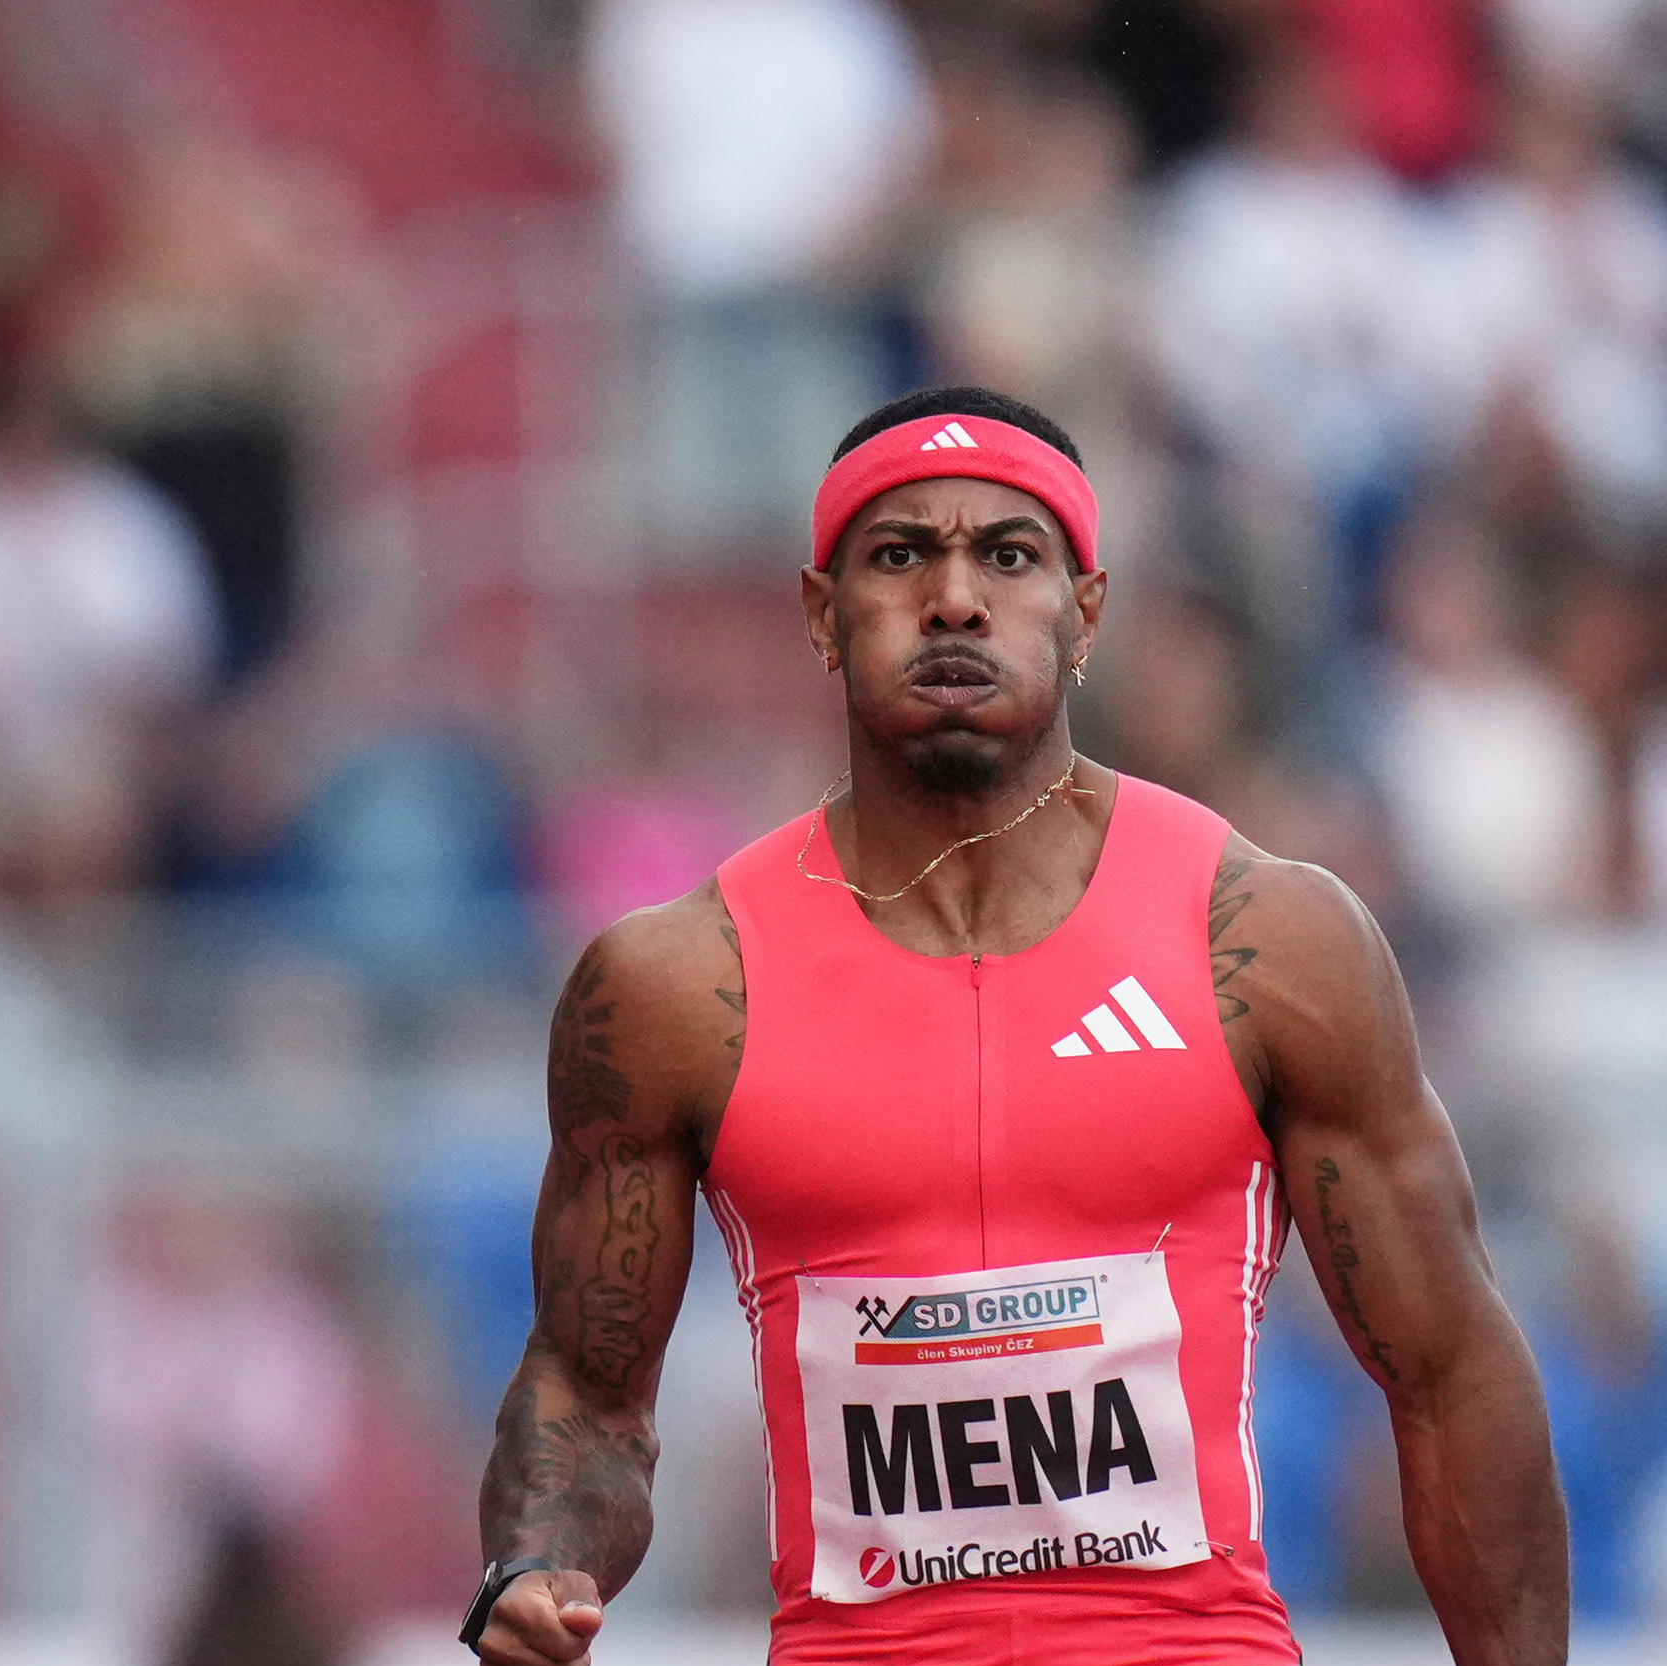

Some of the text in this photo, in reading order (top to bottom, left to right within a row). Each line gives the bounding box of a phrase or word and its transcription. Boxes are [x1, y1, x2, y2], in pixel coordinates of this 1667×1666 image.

[913, 1286, 1088, 1330] SD GROUP
[917, 1337, 1034, 1360] člen Skupiny ČEZ
[842, 1377, 1158, 1516] MENA
[899, 1519, 1168, 1586] UniCredit Bank
